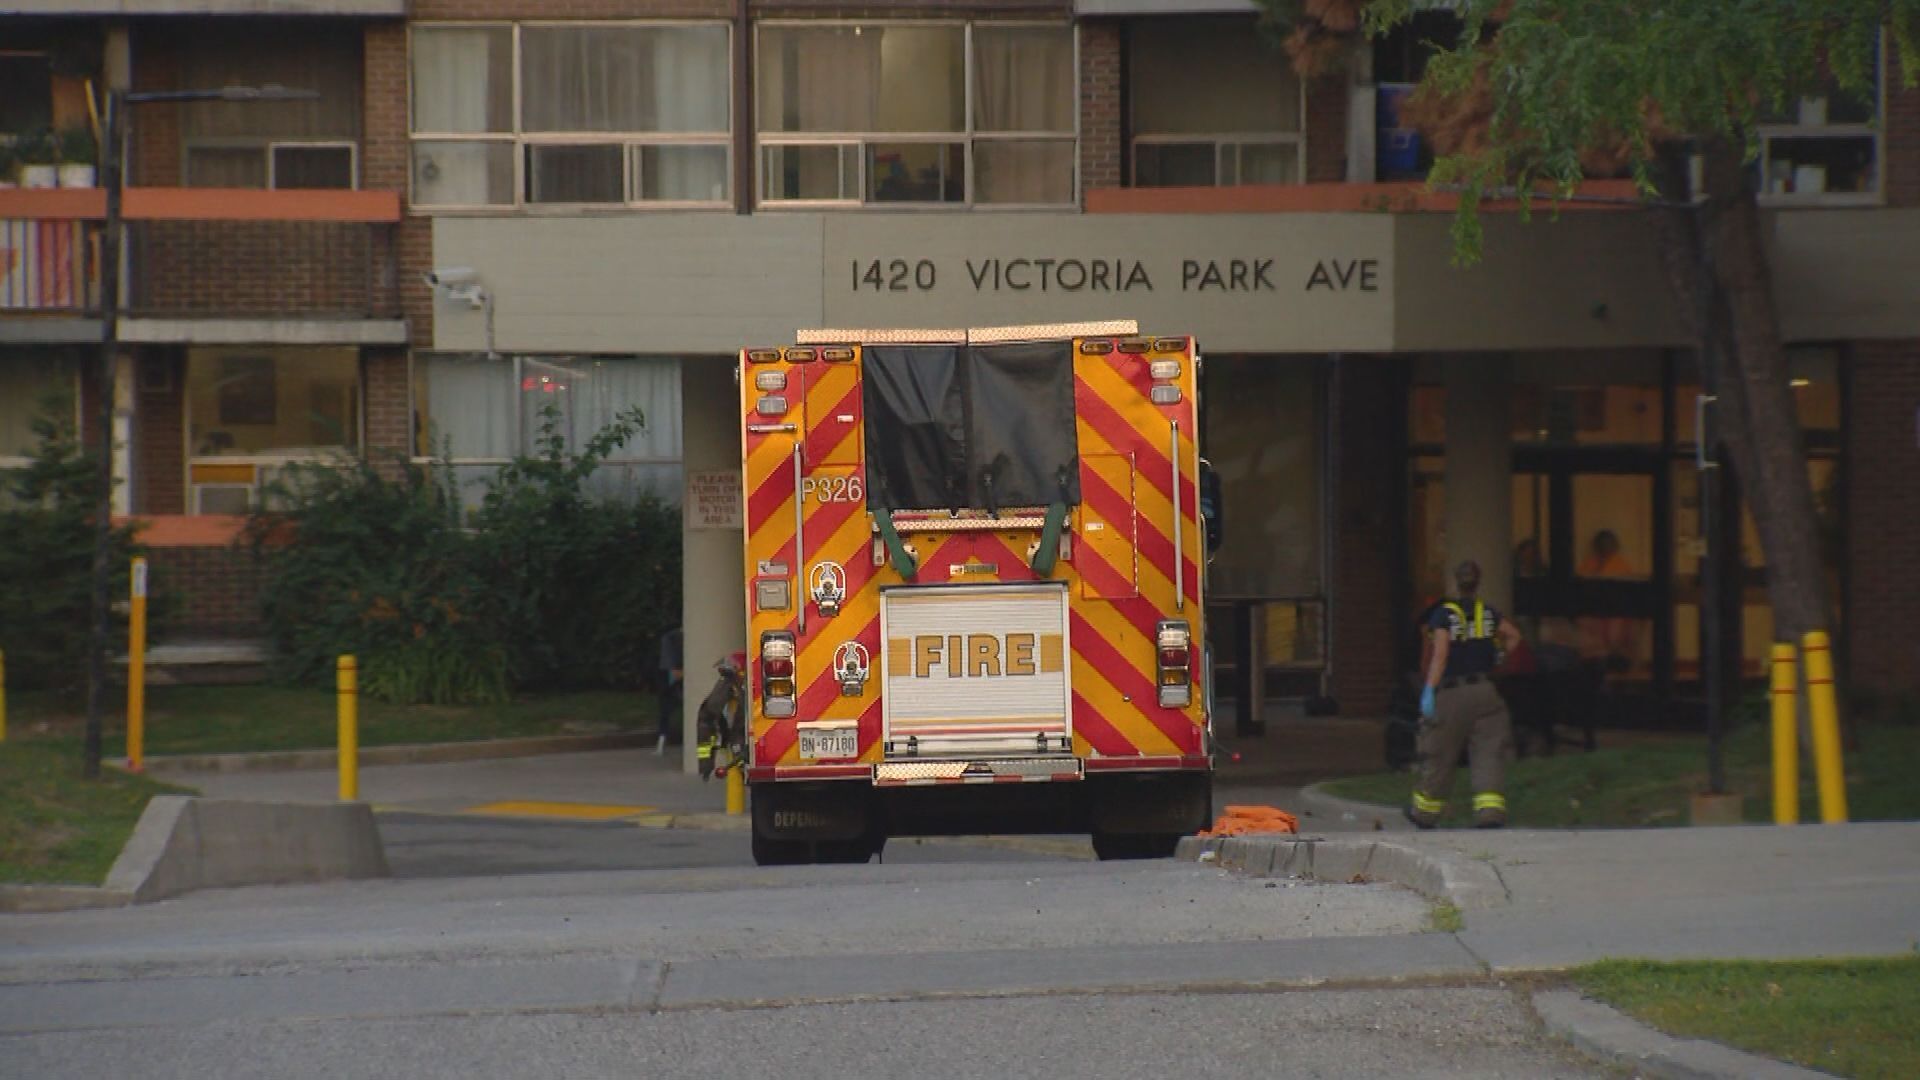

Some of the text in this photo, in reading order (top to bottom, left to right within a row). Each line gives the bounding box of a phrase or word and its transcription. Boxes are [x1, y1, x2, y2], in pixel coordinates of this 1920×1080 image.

[851, 257, 1379, 292] 1420 VICTORIA PARK AVE
[801, 475, 863, 503] P326
[915, 632, 1036, 679] FIRE
